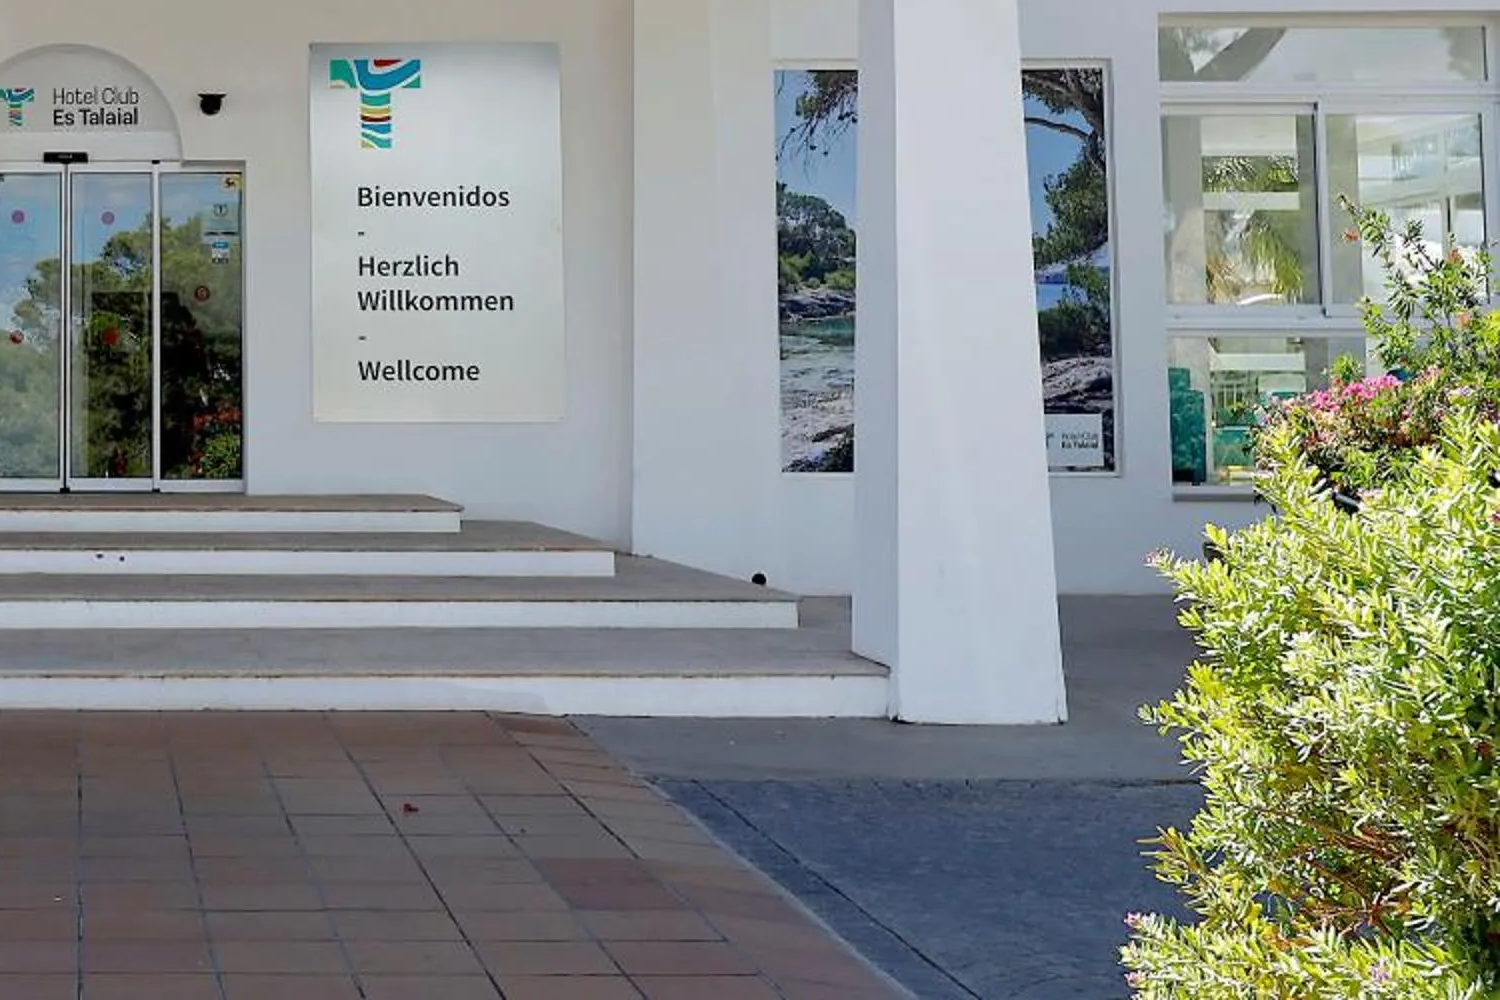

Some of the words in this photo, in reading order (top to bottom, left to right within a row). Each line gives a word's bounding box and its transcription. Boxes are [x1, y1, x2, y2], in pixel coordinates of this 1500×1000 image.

[53, 87, 98, 105] Hotel
[101, 87, 140, 105] Club
[53, 108, 75, 126] Es
[78, 107, 139, 126] Talaial
[357, 185, 510, 208] Bienvenidos
[358, 254, 460, 278] Herzlich
[357, 289, 514, 312] Willkommen
[358, 359, 481, 382] Wellcome
